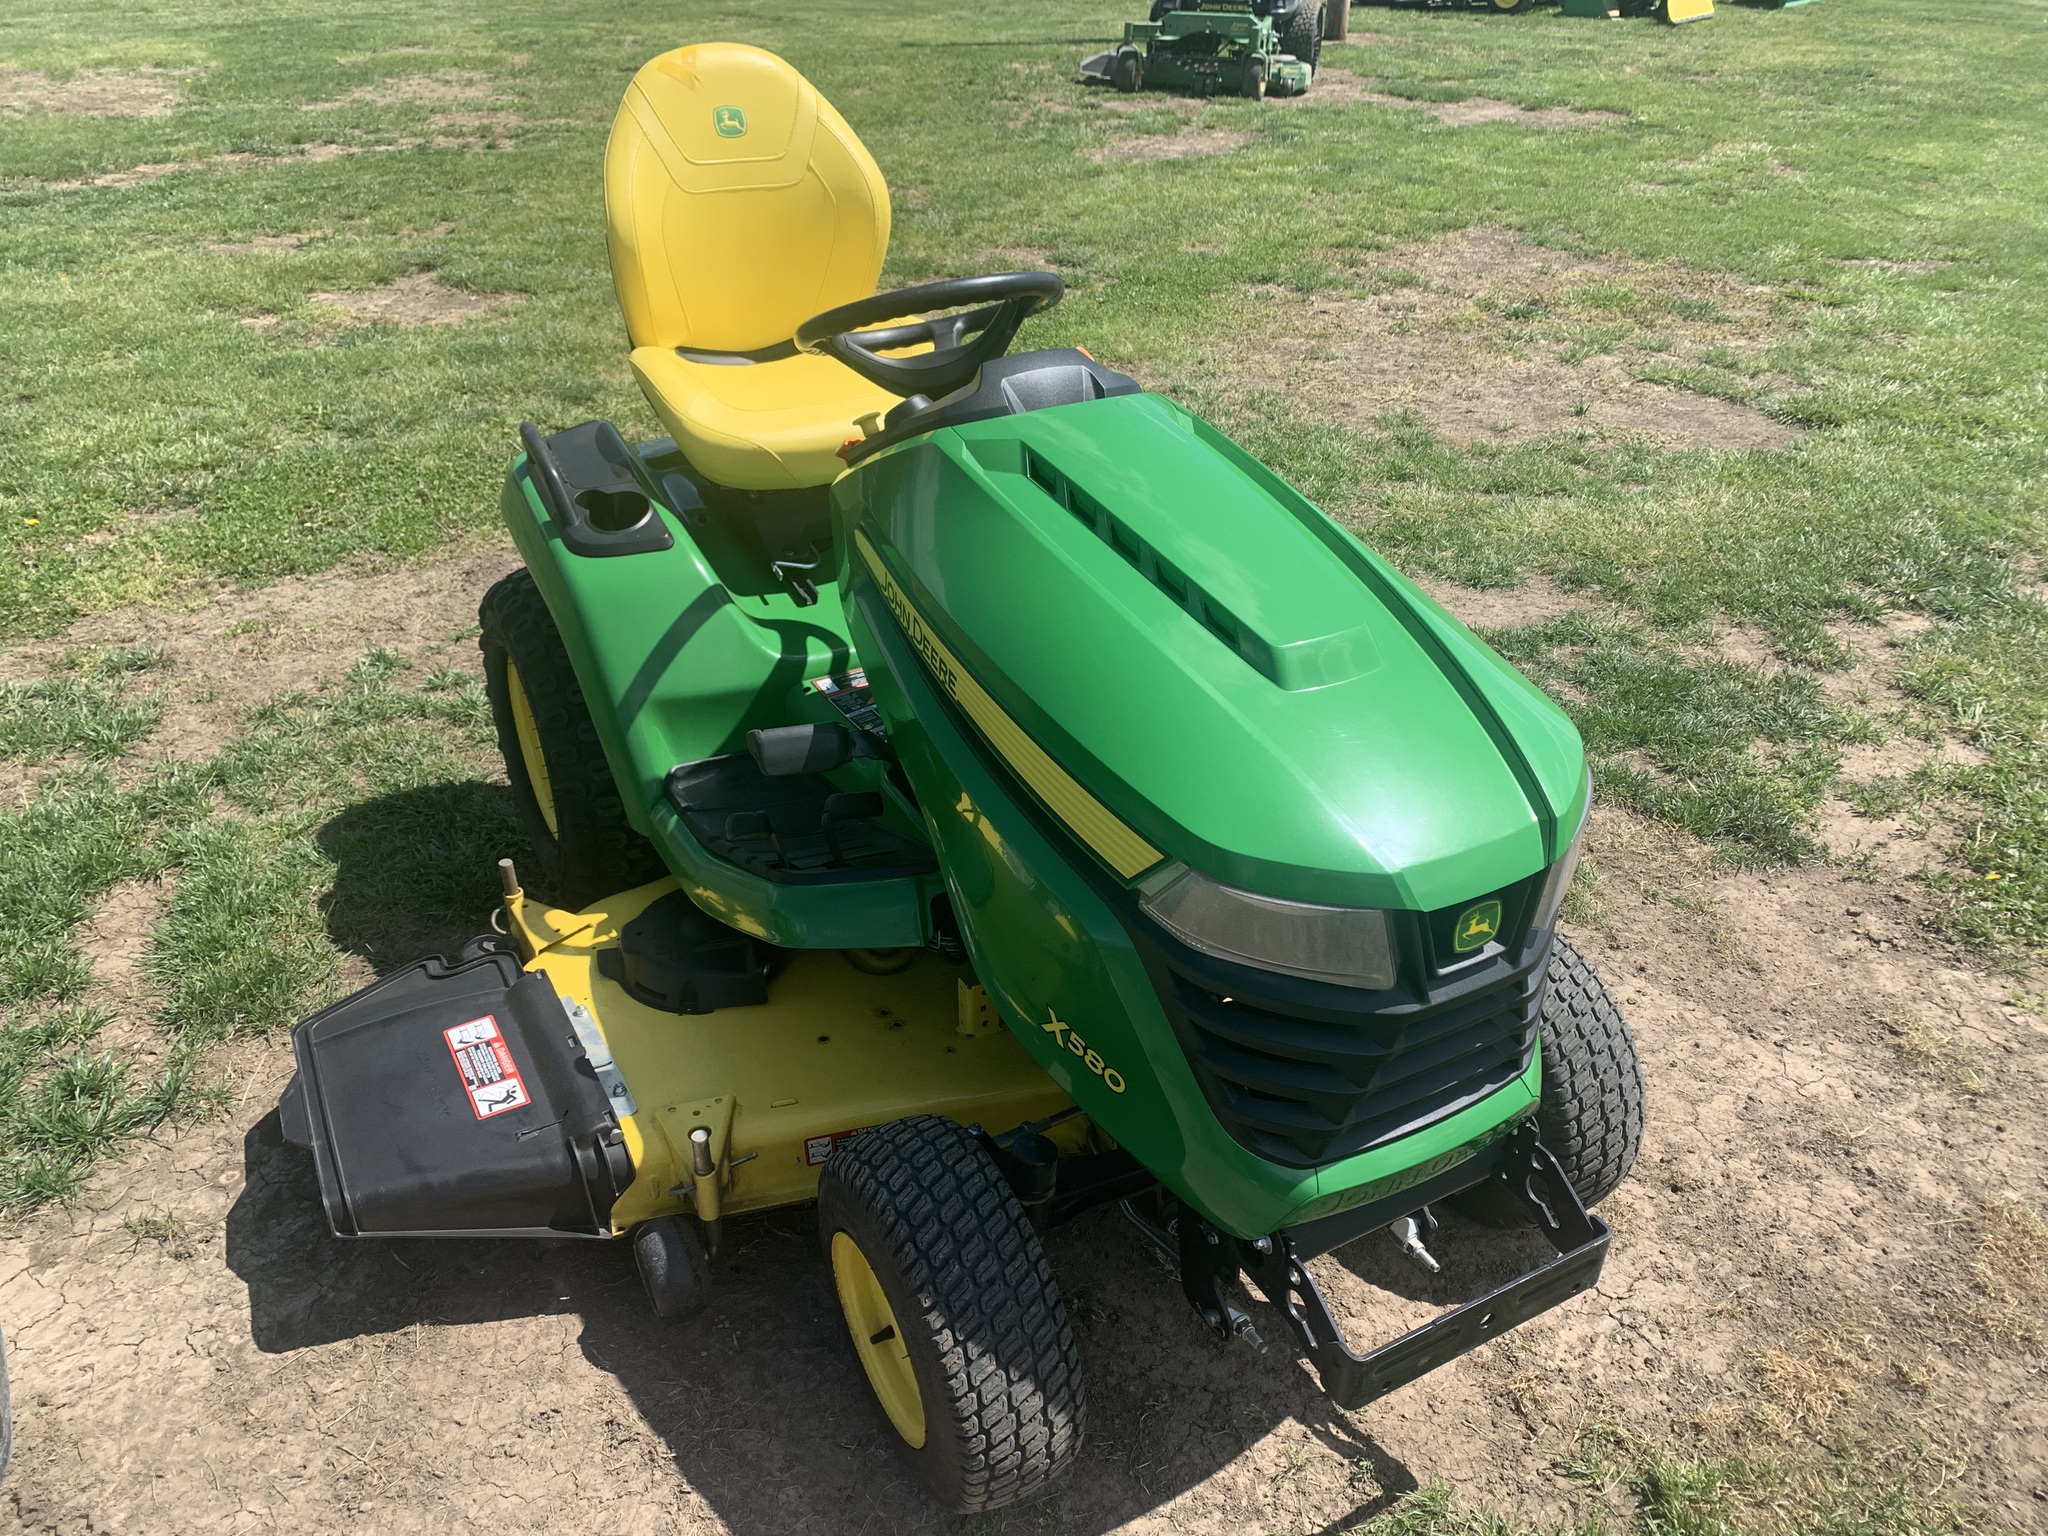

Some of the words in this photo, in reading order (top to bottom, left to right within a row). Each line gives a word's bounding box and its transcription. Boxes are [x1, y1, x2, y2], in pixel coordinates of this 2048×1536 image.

[881, 571, 910, 632] JOHN
[913, 616, 958, 697] DEERE
[496, 1047, 515, 1075] DANGER
[1039, 1002, 1127, 1094] X580
